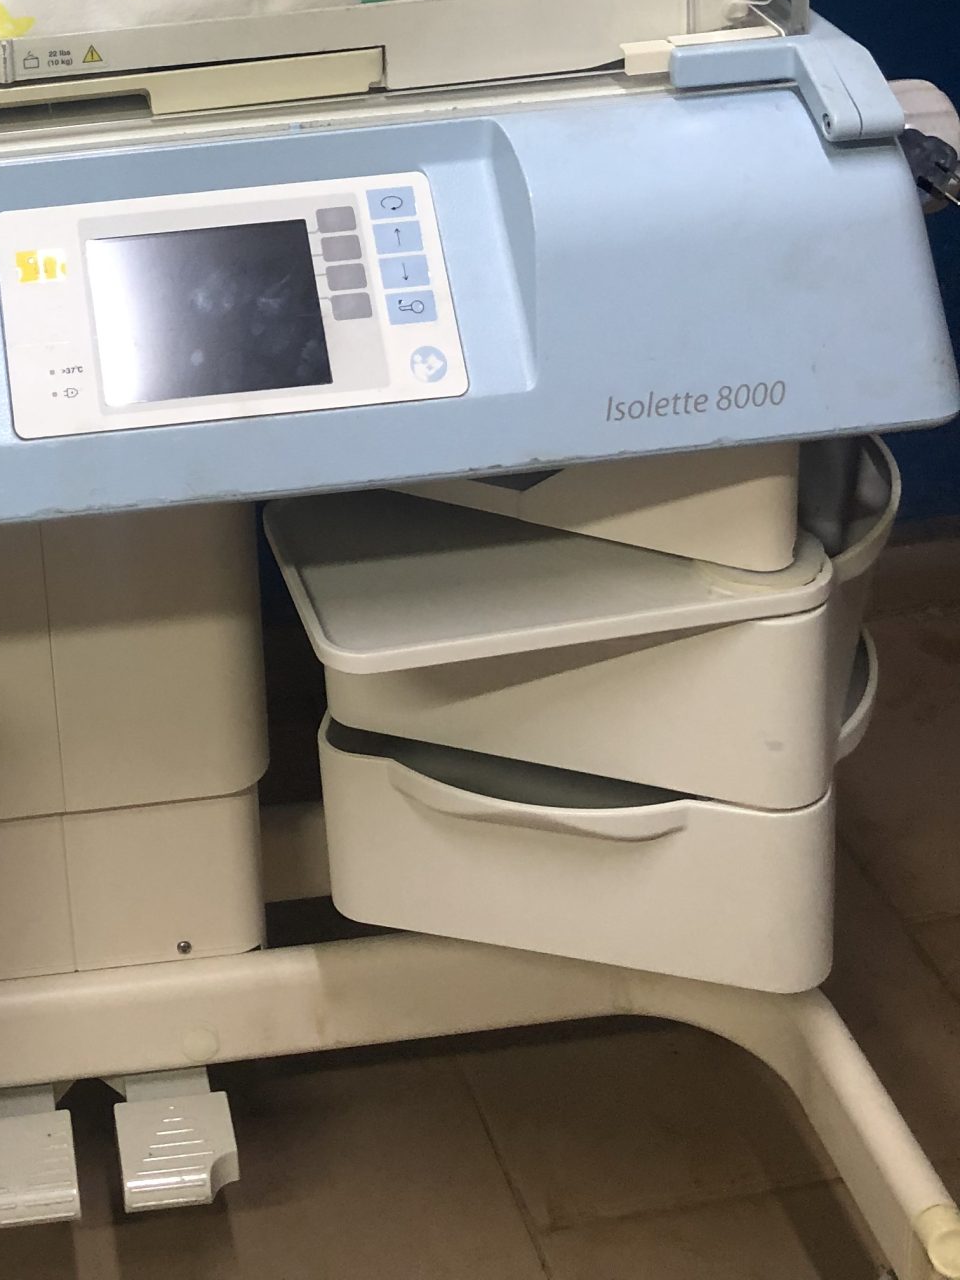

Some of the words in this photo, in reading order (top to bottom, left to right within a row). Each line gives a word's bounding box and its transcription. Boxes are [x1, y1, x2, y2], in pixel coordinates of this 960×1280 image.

[48, 50, 58, 58] 22
[48, 59, 60, 67] (10
[60, 57, 73, 66] kg)
[606, 391, 709, 422] Isolette
[716, 380, 786, 411] 8000
